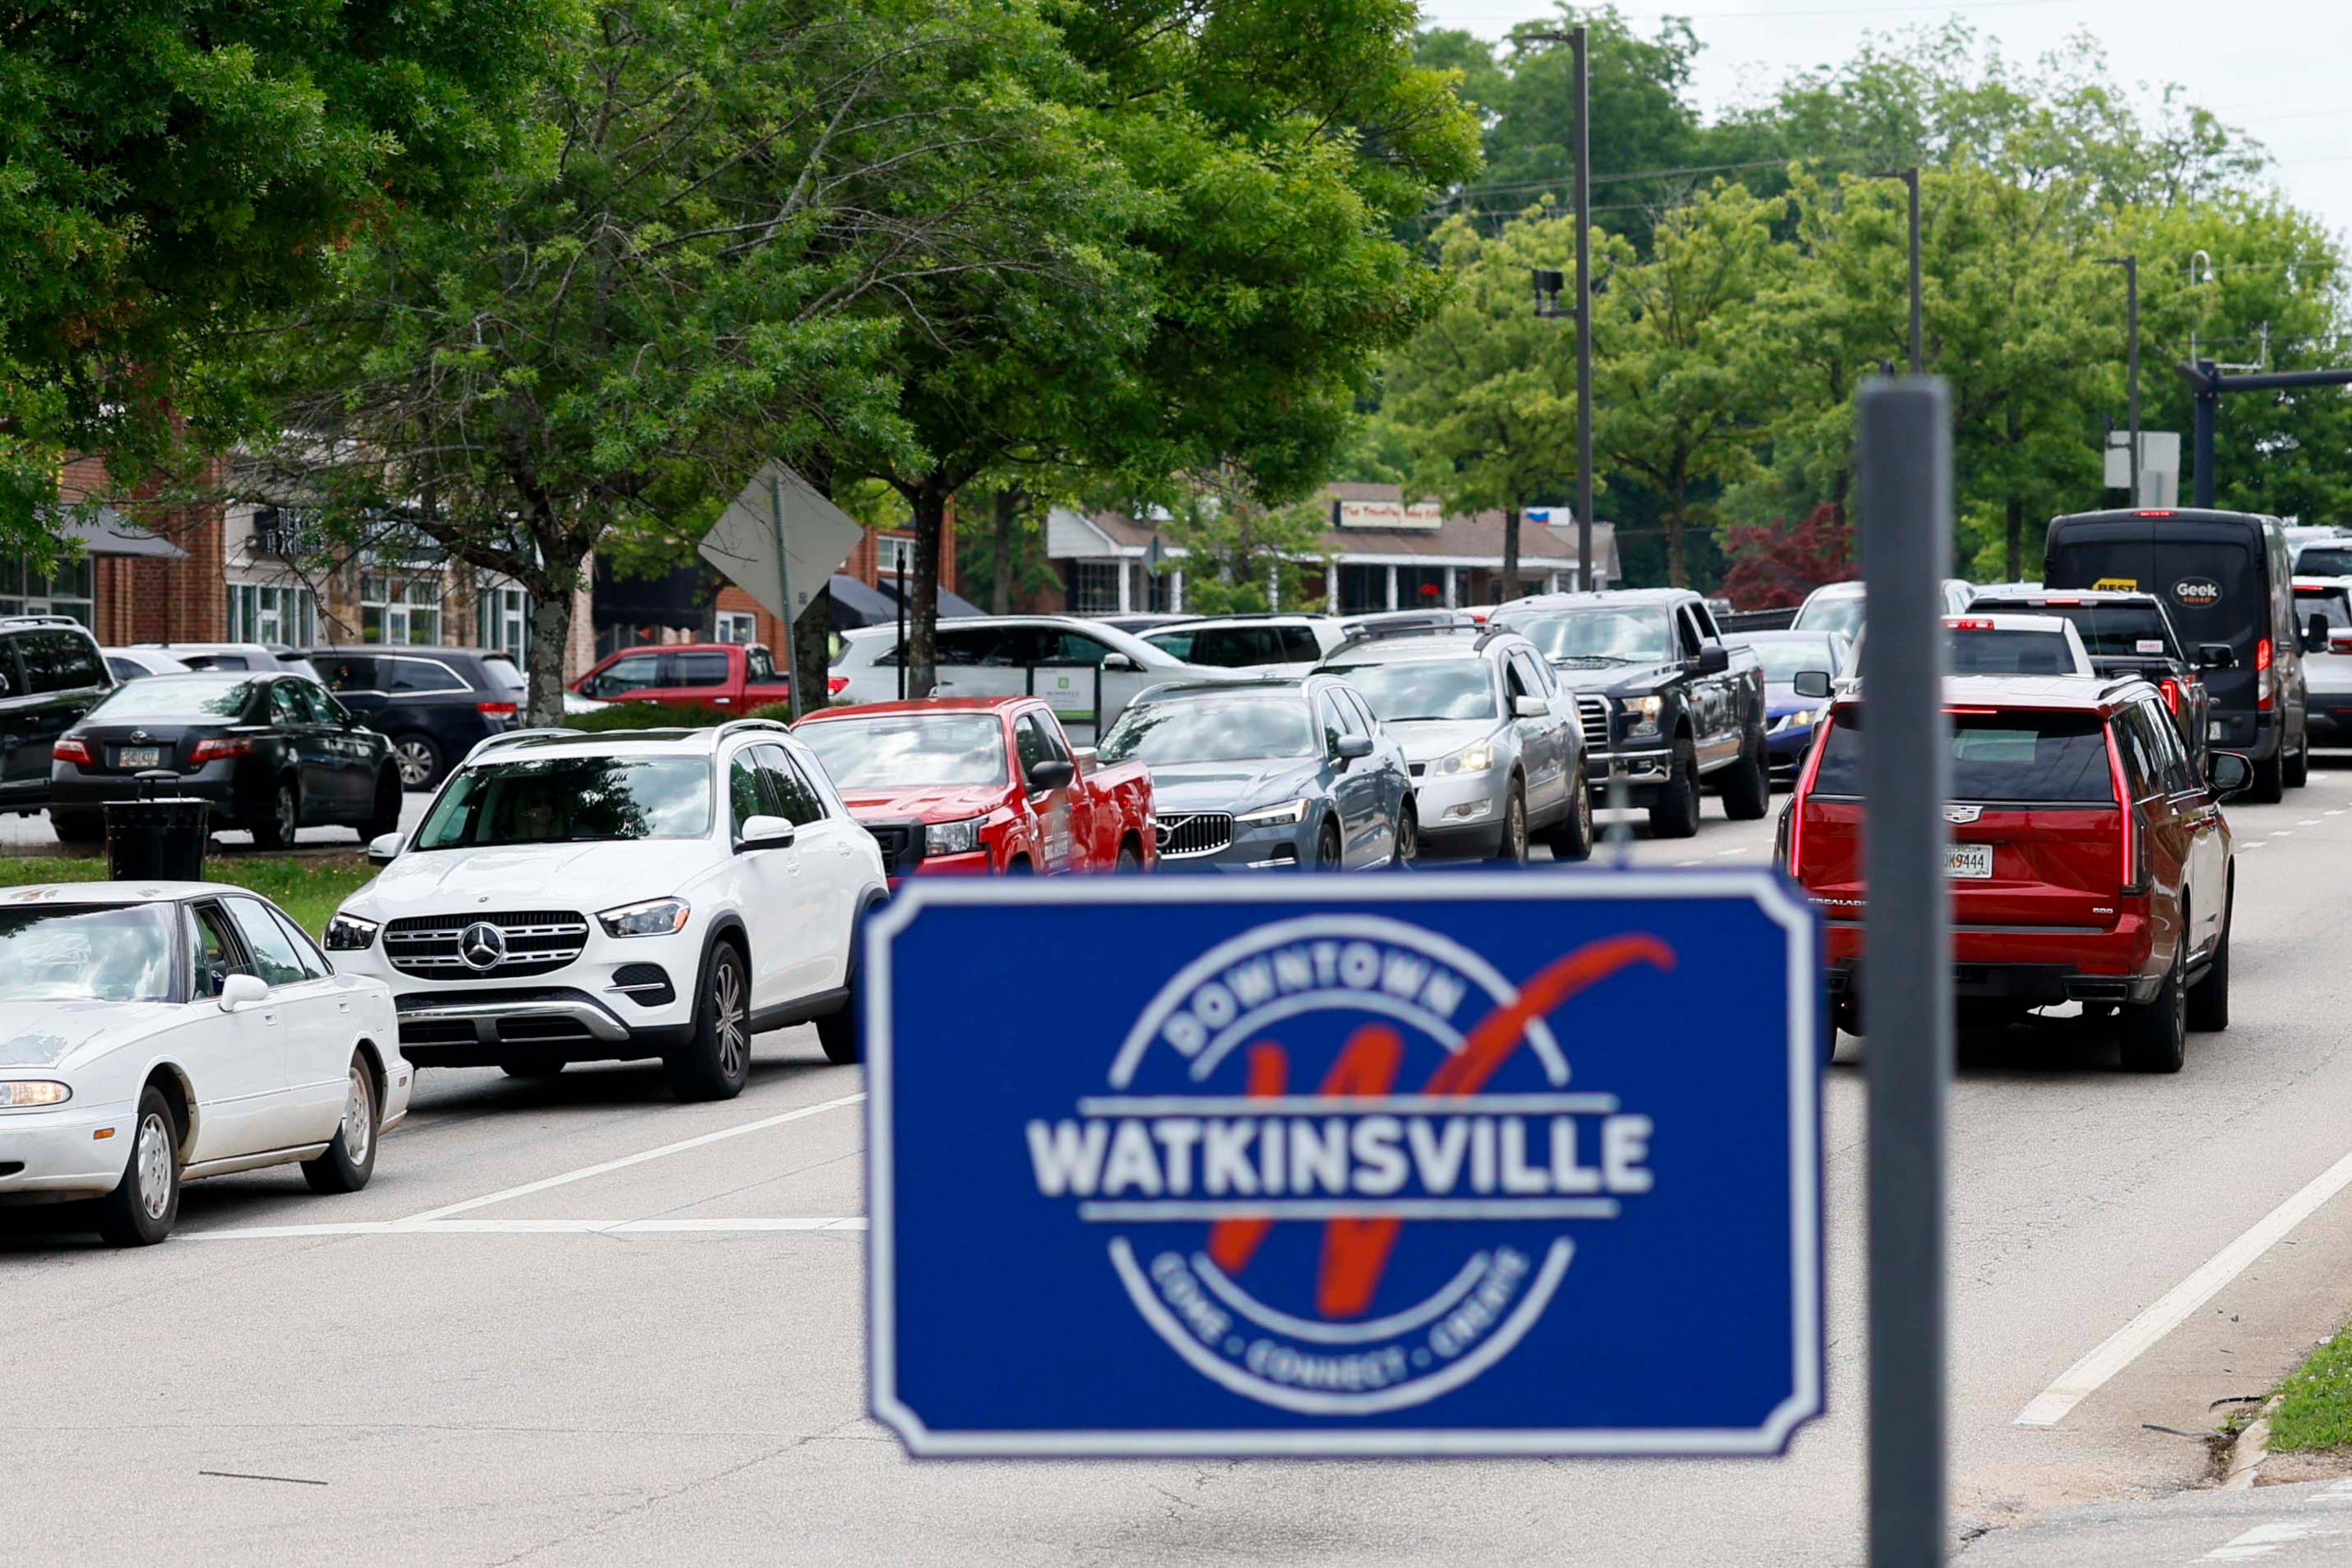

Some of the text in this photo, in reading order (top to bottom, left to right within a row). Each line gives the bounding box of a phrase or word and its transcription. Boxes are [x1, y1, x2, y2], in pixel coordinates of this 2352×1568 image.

[2098, 583, 2135, 592] BEST
[2176, 582, 2217, 597] Geek
[1161, 940, 1467, 1058] DOWNTOWN
[1025, 1114, 1654, 1198] WATKINSVILLE
[1245, 1338, 1409, 1390] CONNECT
